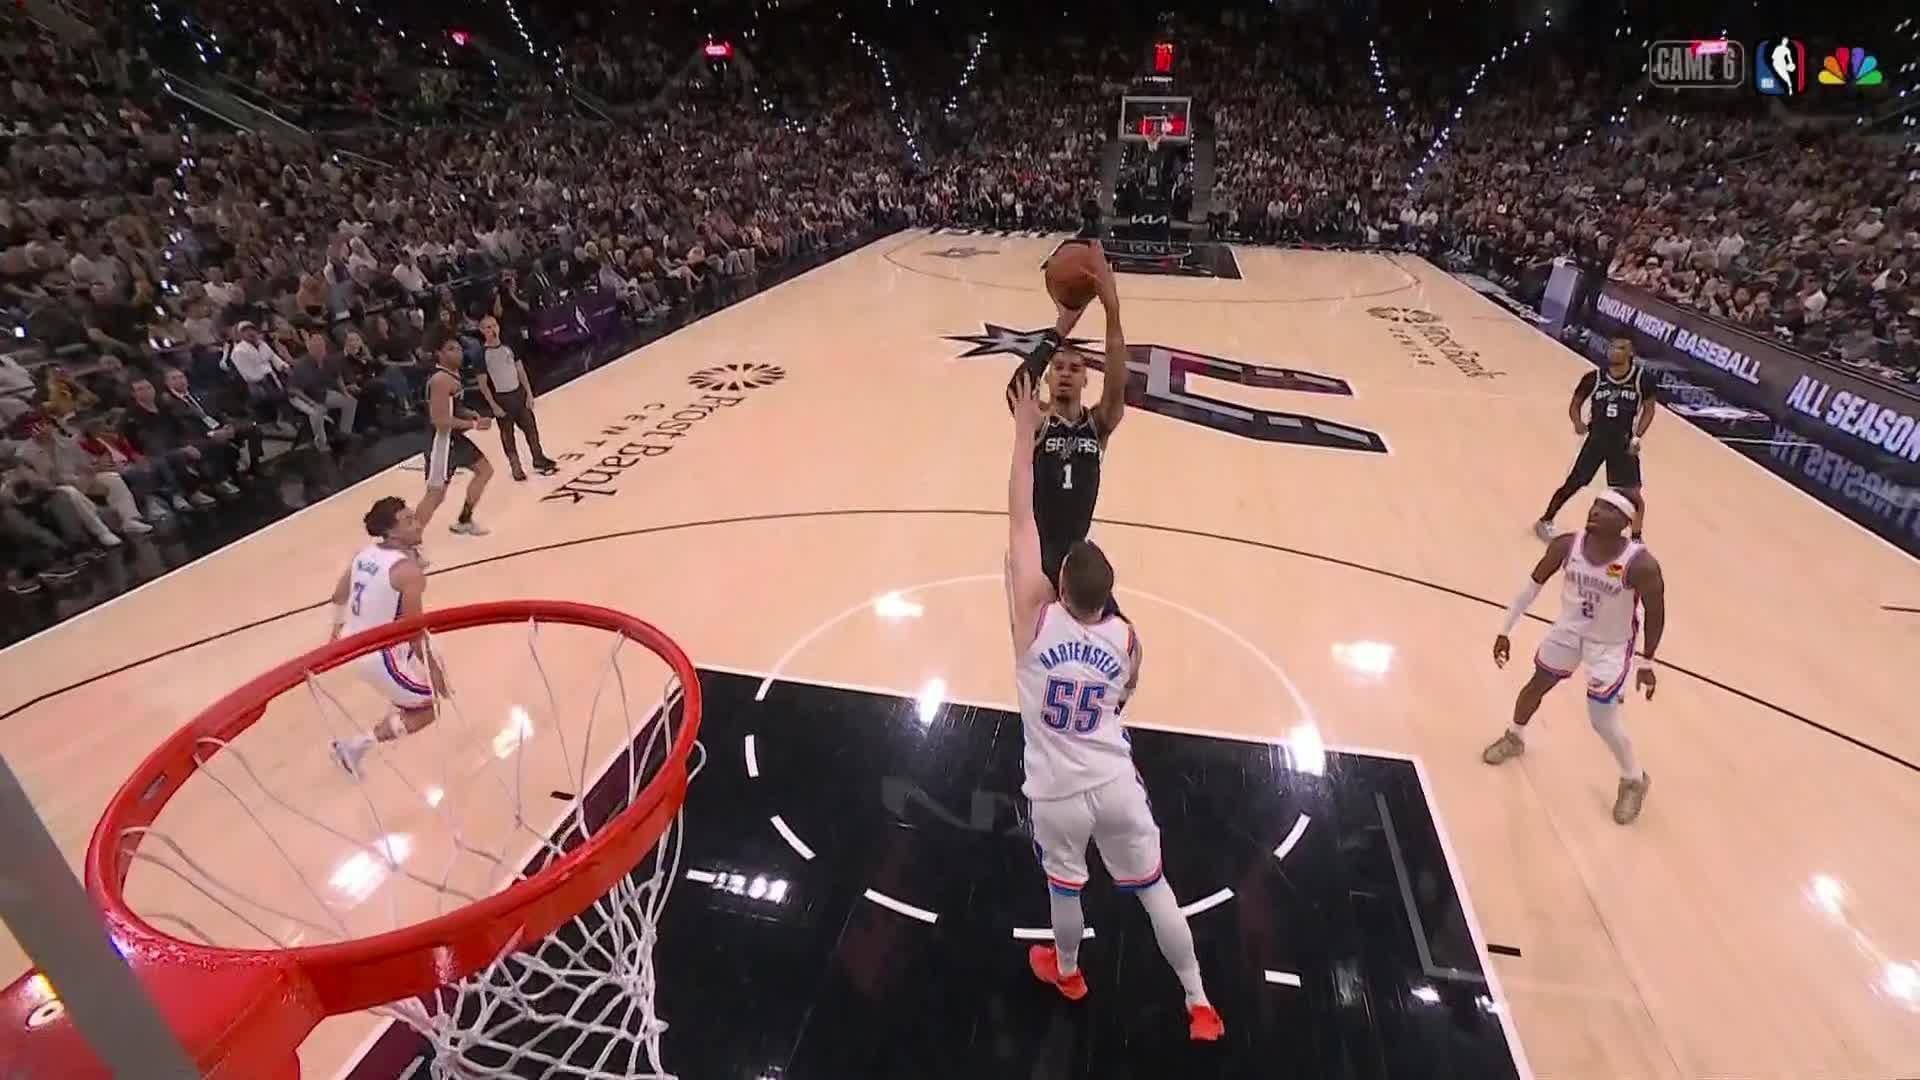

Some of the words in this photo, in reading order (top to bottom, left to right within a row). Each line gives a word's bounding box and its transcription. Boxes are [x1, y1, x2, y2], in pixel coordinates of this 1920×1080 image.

[1597, 293, 1636, 324] UNDAY
[1633, 311, 1676, 343] NIGHT
[1673, 328, 1761, 385] BASEBALL
[1607, 403, 1618, 417] 5
[1786, 375, 1830, 418] ALL
[540, 443, 672, 504] Bank
[1062, 464, 1073, 489] 1
[351, 582, 366, 616] 3
[1582, 601, 1594, 619] 2
[1041, 676, 1107, 733] 55
